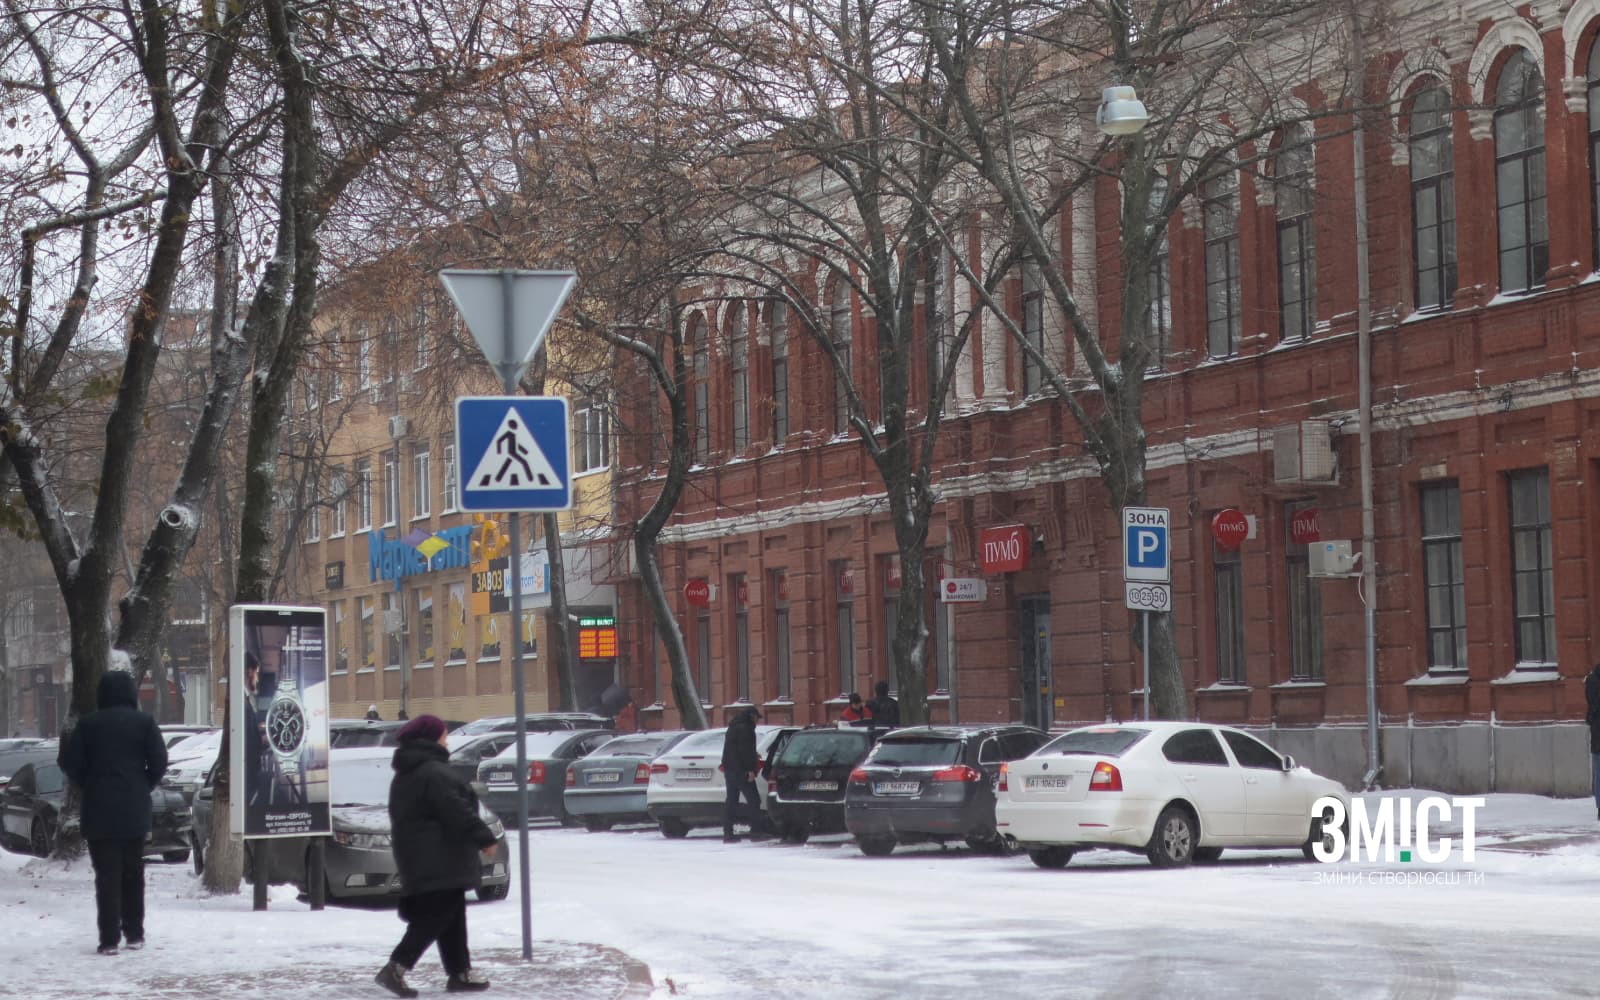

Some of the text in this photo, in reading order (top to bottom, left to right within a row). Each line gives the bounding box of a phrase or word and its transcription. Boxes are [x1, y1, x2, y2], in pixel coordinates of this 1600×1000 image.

[1128, 513, 1166, 525] ЗОНА
[1138, 530, 1159, 563] P
[476, 569, 503, 592] ЗАВОЗ
[1131, 591, 1165, 603] 10 25 50
